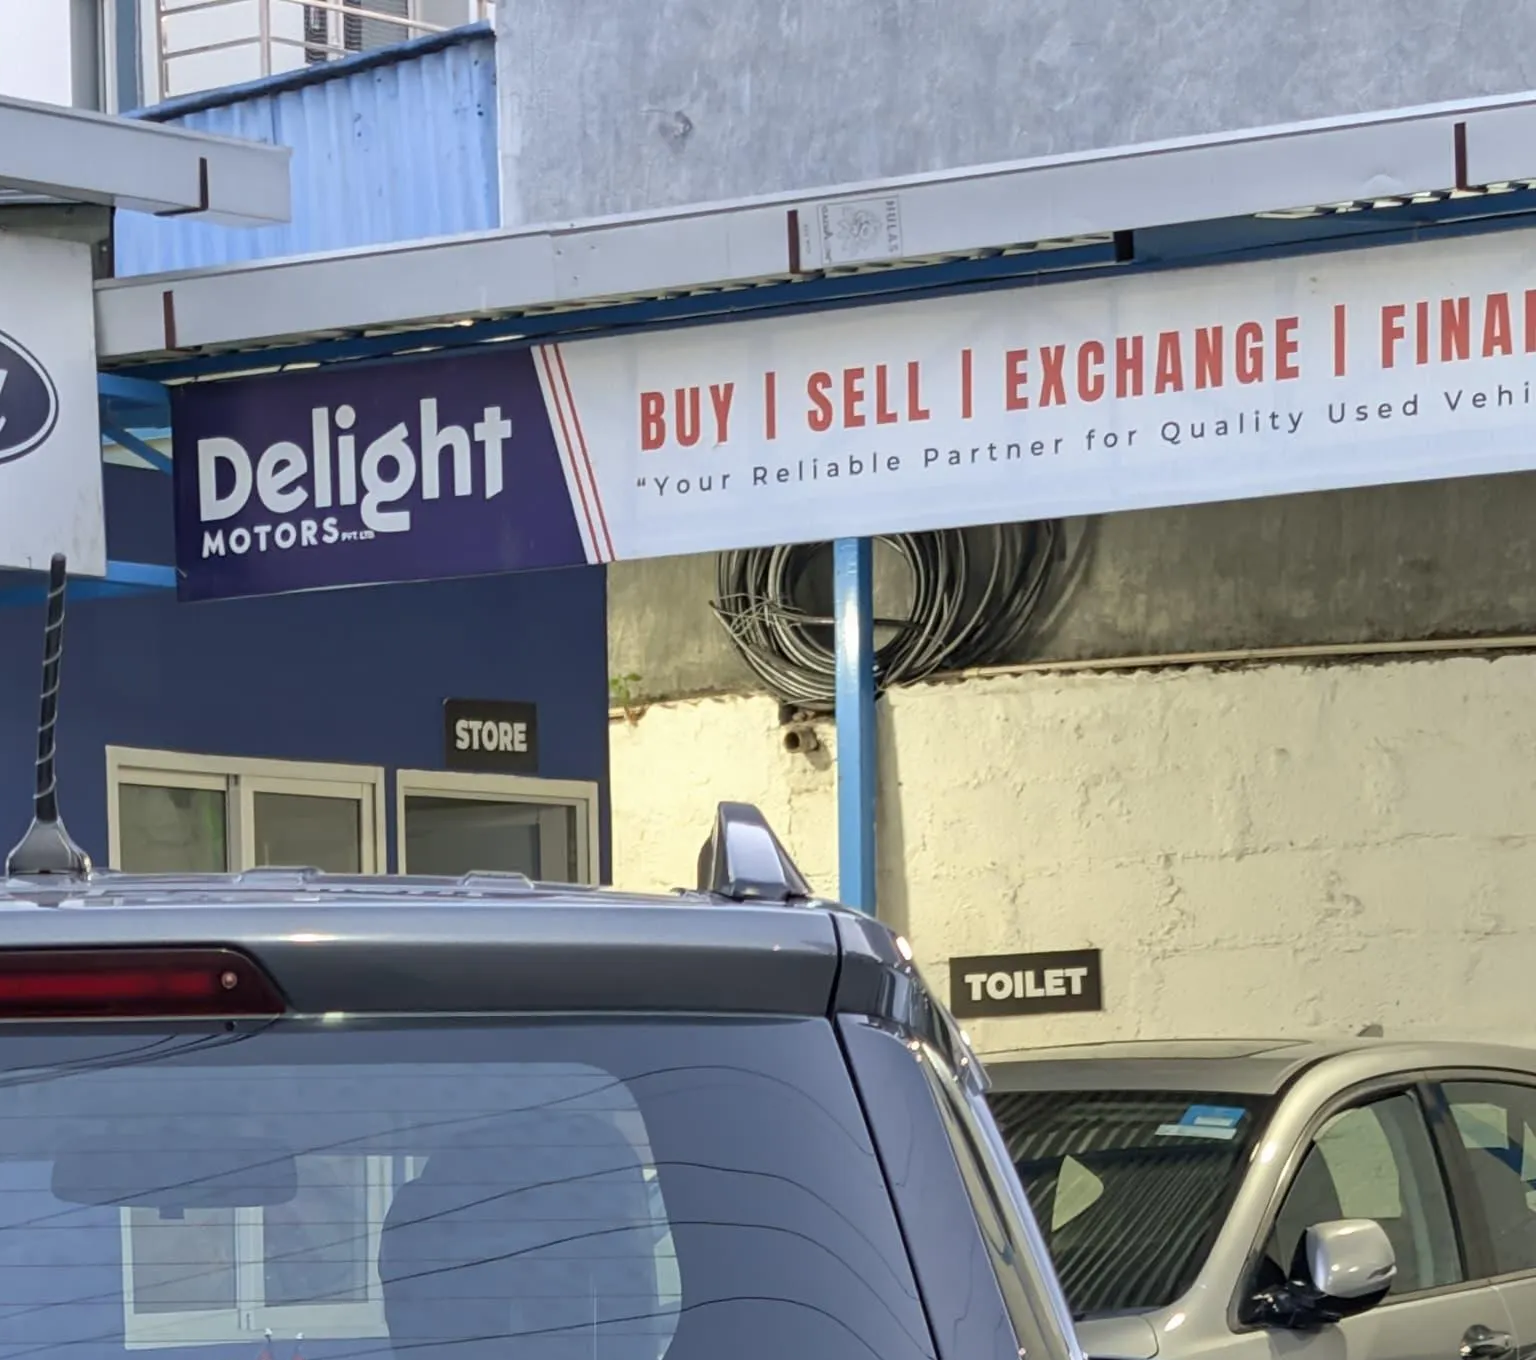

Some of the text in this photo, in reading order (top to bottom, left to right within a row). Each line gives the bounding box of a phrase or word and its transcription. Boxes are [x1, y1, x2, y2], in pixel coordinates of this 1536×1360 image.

[640, 382, 734, 451] BUY
[807, 361, 930, 432] SELL
[1006, 316, 1300, 412] EXCHANGE
[197, 398, 512, 532] Delight
[753, 452, 900, 486] Reliable
[924, 436, 1063, 467] Partner
[1087, 428, 1137, 451] for
[1161, 411, 1303, 445] Quality
[1329, 394, 1418, 424] Used
[1444, 381, 1529, 412] Vehi
[202, 517, 339, 558] MOTORS
[456, 719, 527, 752] STORE
[965, 967, 1087, 1001] TOILET
